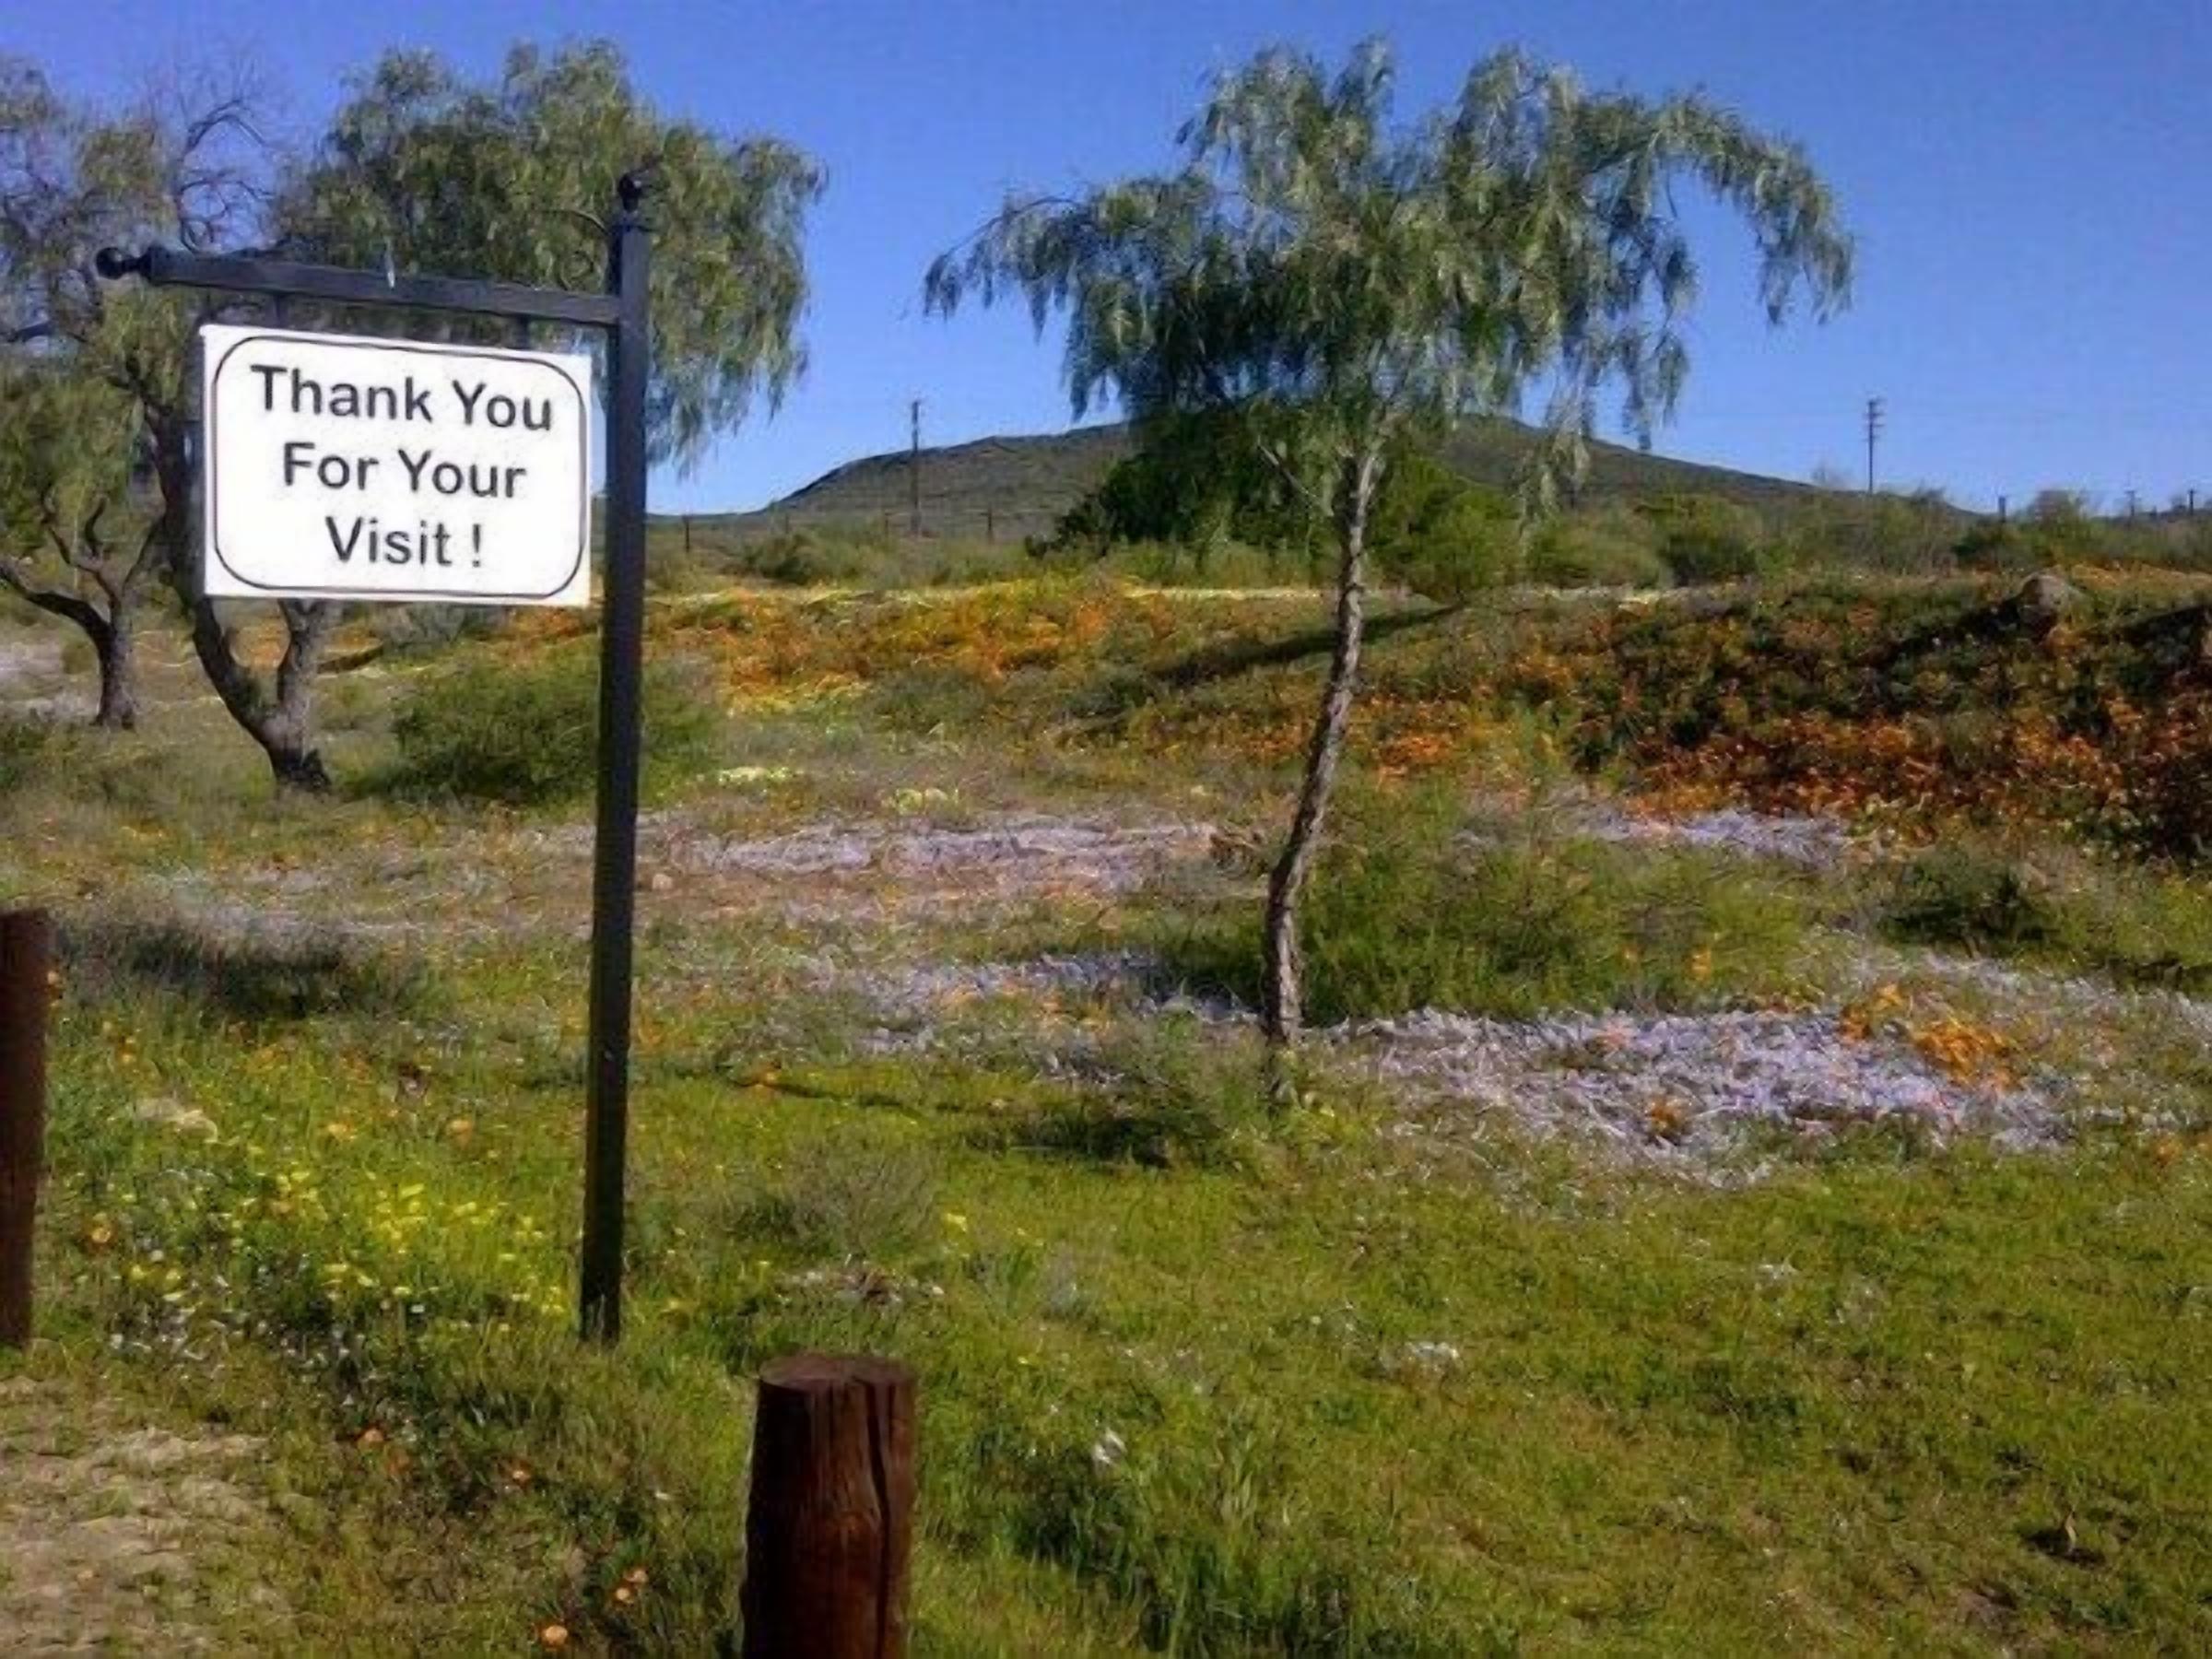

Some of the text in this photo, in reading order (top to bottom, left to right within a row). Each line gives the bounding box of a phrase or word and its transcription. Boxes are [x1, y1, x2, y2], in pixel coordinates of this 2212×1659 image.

[249, 364, 551, 430] Thank You
[283, 441, 526, 498] For Your
[324, 516, 453, 565] Visit
